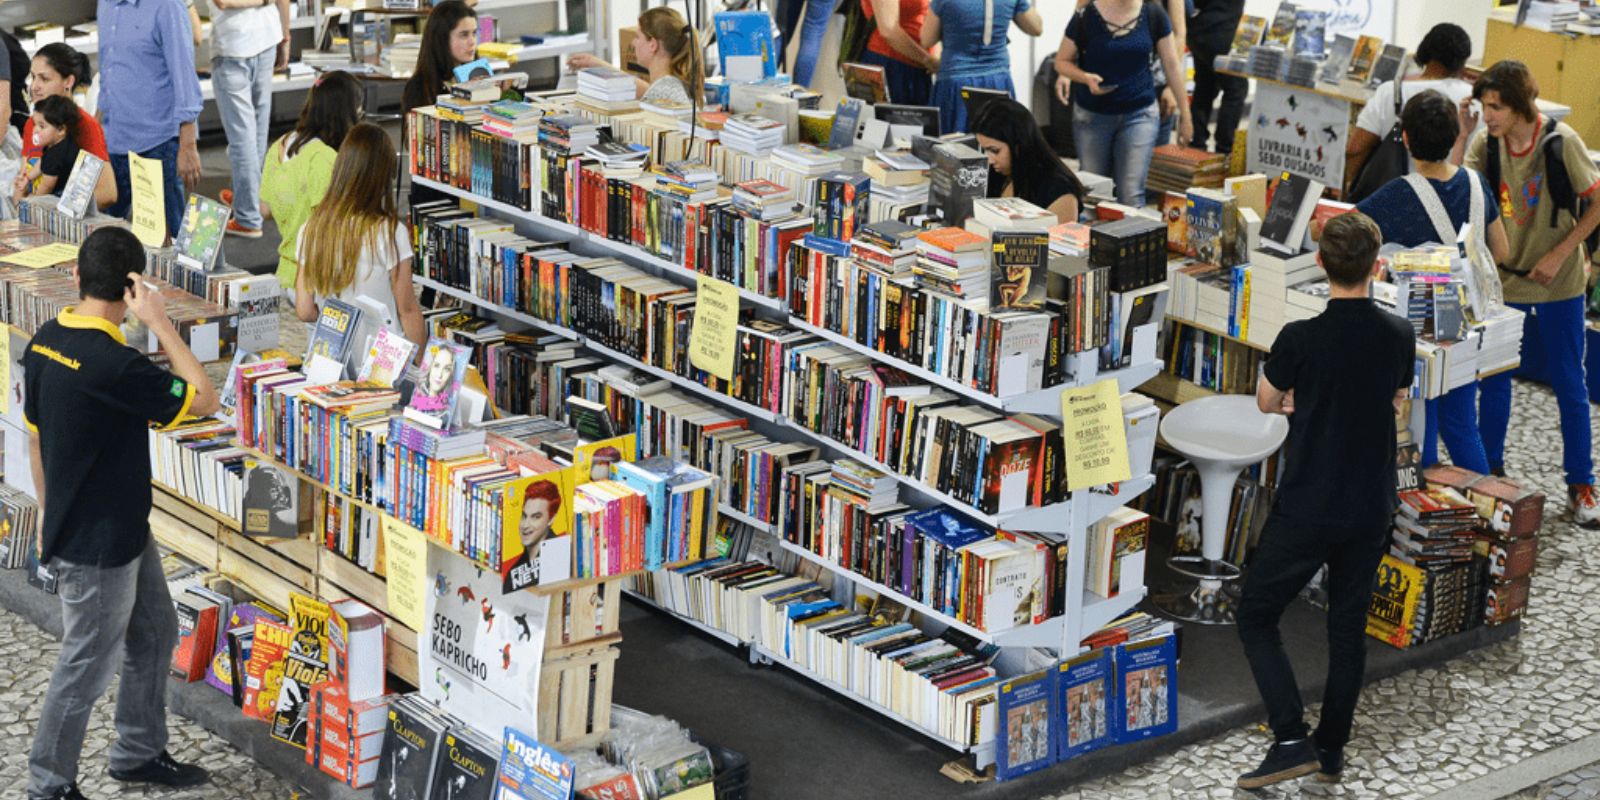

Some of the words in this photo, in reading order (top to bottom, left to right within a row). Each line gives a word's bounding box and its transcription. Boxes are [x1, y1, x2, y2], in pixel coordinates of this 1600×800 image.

[1258, 138, 1301, 157] LIVRARIA
[1304, 148, 1311, 160] &
[1258, 151, 1282, 167] SEBO
[1284, 157, 1326, 178] OUSADOS
[510, 559, 541, 577] FELIP
[511, 567, 540, 590] NET
[996, 572, 1027, 586] CONTRATO
[1369, 595, 1405, 625] EPPELIN
[255, 623, 289, 649] CHI
[296, 612, 329, 638] VIOL
[433, 612, 462, 644] SEBO
[432, 633, 488, 681] KAPRICHO
[393, 719, 427, 749] CLAPTON
[449, 747, 486, 777] CLAPTON
[508, 732, 561, 777] Inglês
